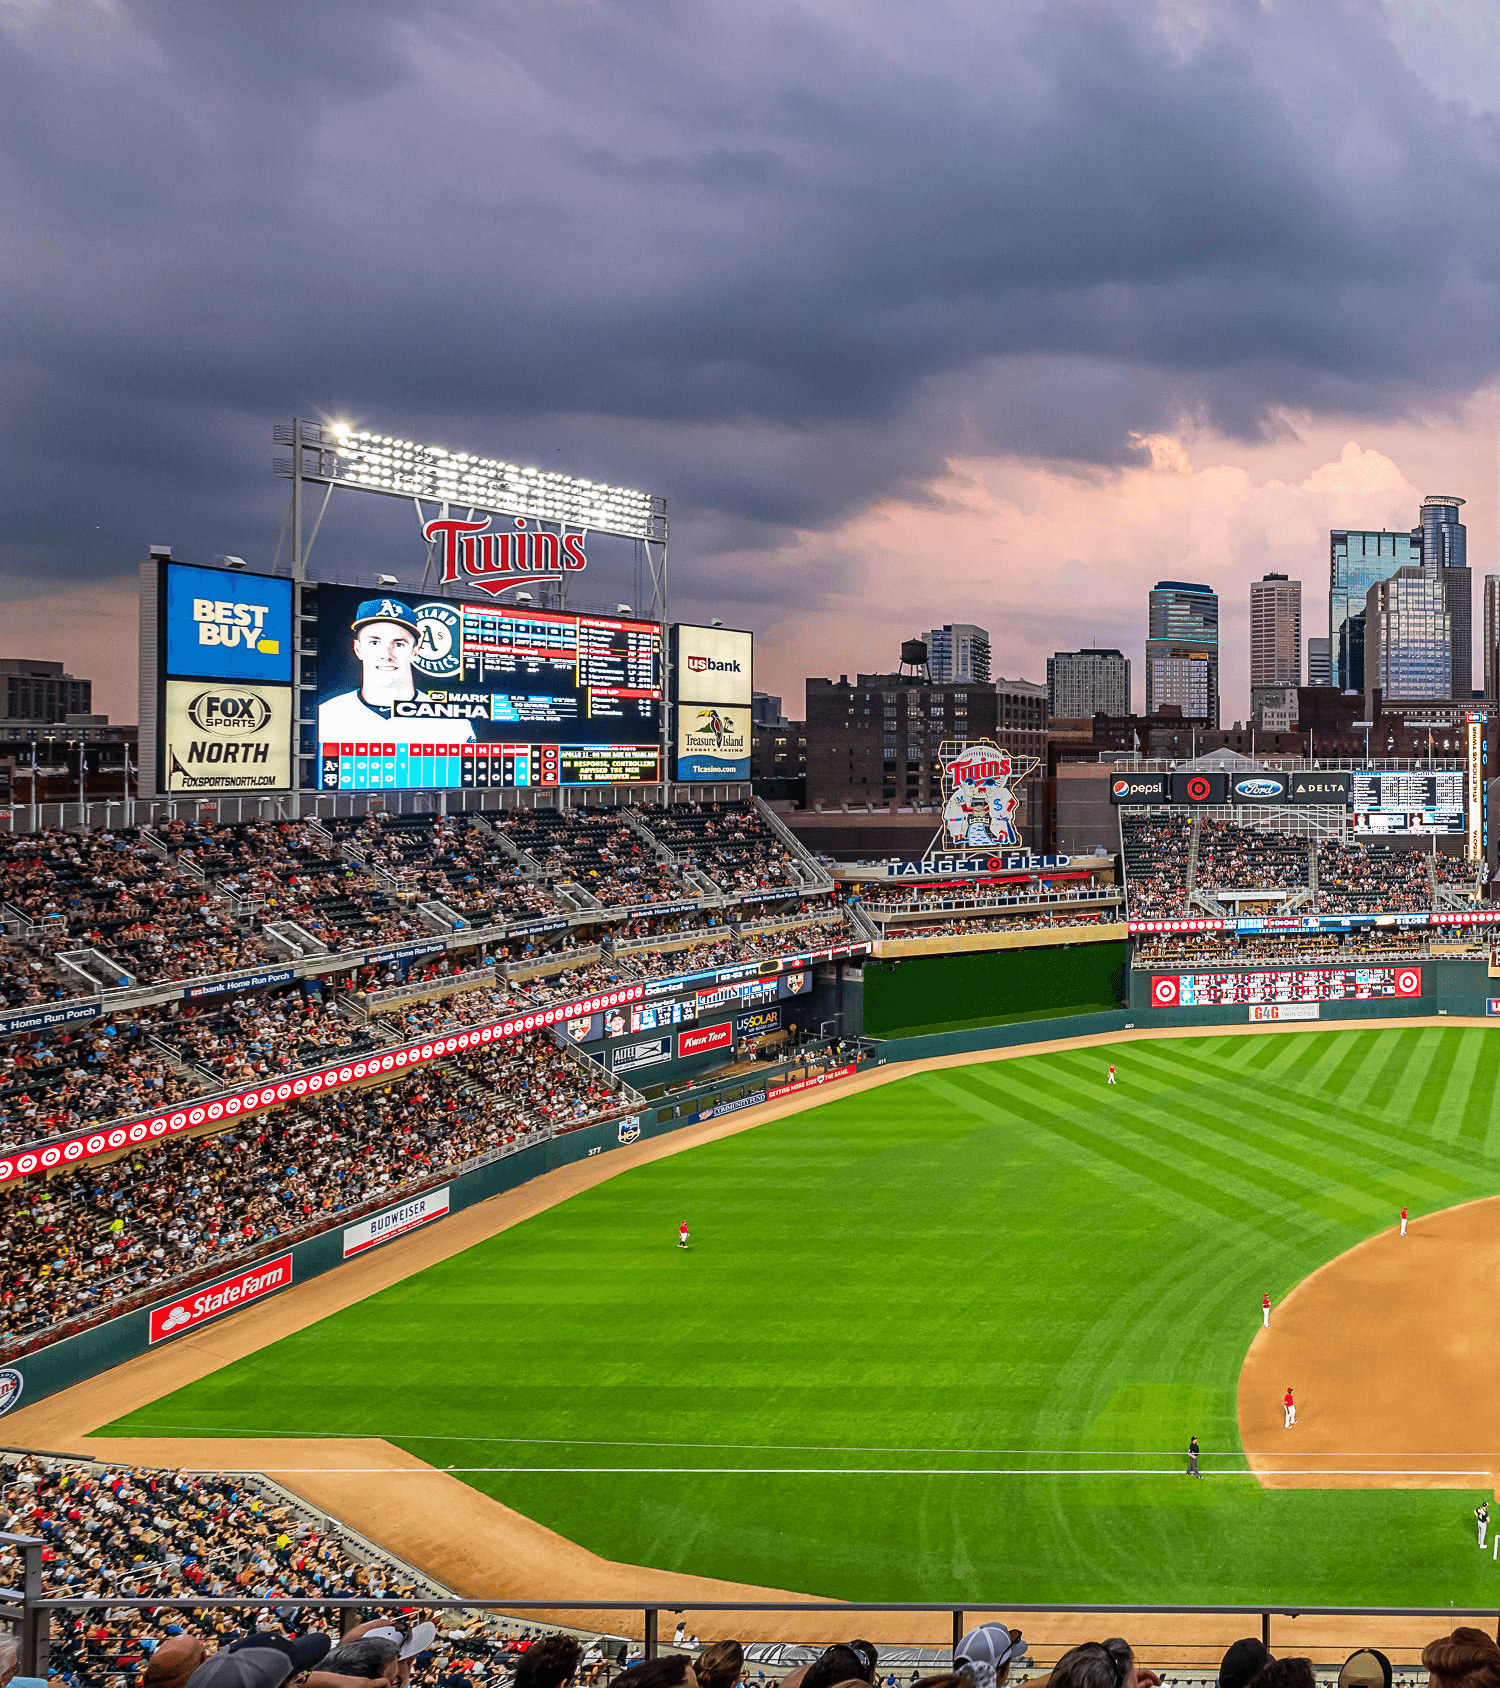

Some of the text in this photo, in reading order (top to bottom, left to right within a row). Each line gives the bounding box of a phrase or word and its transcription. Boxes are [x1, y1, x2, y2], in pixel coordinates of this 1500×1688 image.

[422, 515, 587, 584] Twins
[193, 598, 269, 628] BEST
[198, 623, 263, 649] BUY
[688, 656, 741, 672] usbank
[450, 692, 489, 703] MARK
[206, 697, 255, 719] FOX
[396, 703, 489, 718] CANHA
[205, 718, 256, 728] SPORTS
[685, 734, 744, 747] Treasure Island
[187, 741, 270, 763] NORTH
[545, 750, 556, 758] 0
[1482, 740, 1488, 764] GO
[545, 761, 556, 769] 0
[947, 757, 1011, 787] Twins
[182, 776, 276, 788] FOXSPORTSNORTH.COM
[545, 773, 556, 781] 2
[1130, 783, 1162, 794] pepsi
[1244, 784, 1273, 794] Ford
[1309, 784, 1345, 792] DELTA
[889, 855, 1071, 876] TARGET FIELD
[396, 950, 414, 959] Home
[427, 944, 444, 952] Porch
[227, 979, 250, 991] Home
[252, 977, 267, 986] Run
[268, 973, 290, 984] Porch
[645, 982, 683, 996] Odorizzi
[645, 999, 676, 1009] Odorizzi
[10, 1018, 42, 1030] Home
[43, 1012, 65, 1024] Run
[66, 1007, 96, 1020] Porch
[749, 1011, 778, 1027] SOLAR
[1255, 1006, 1279, 1019] G4G
[707, 1032, 727, 1041] TRIP
[768, 1069, 849, 1098] GETTING MORE KIDS THE GAME.
[714, 1092, 766, 1115] COMMUNITY FUND
[370, 1201, 426, 1233] BUDWEISER
